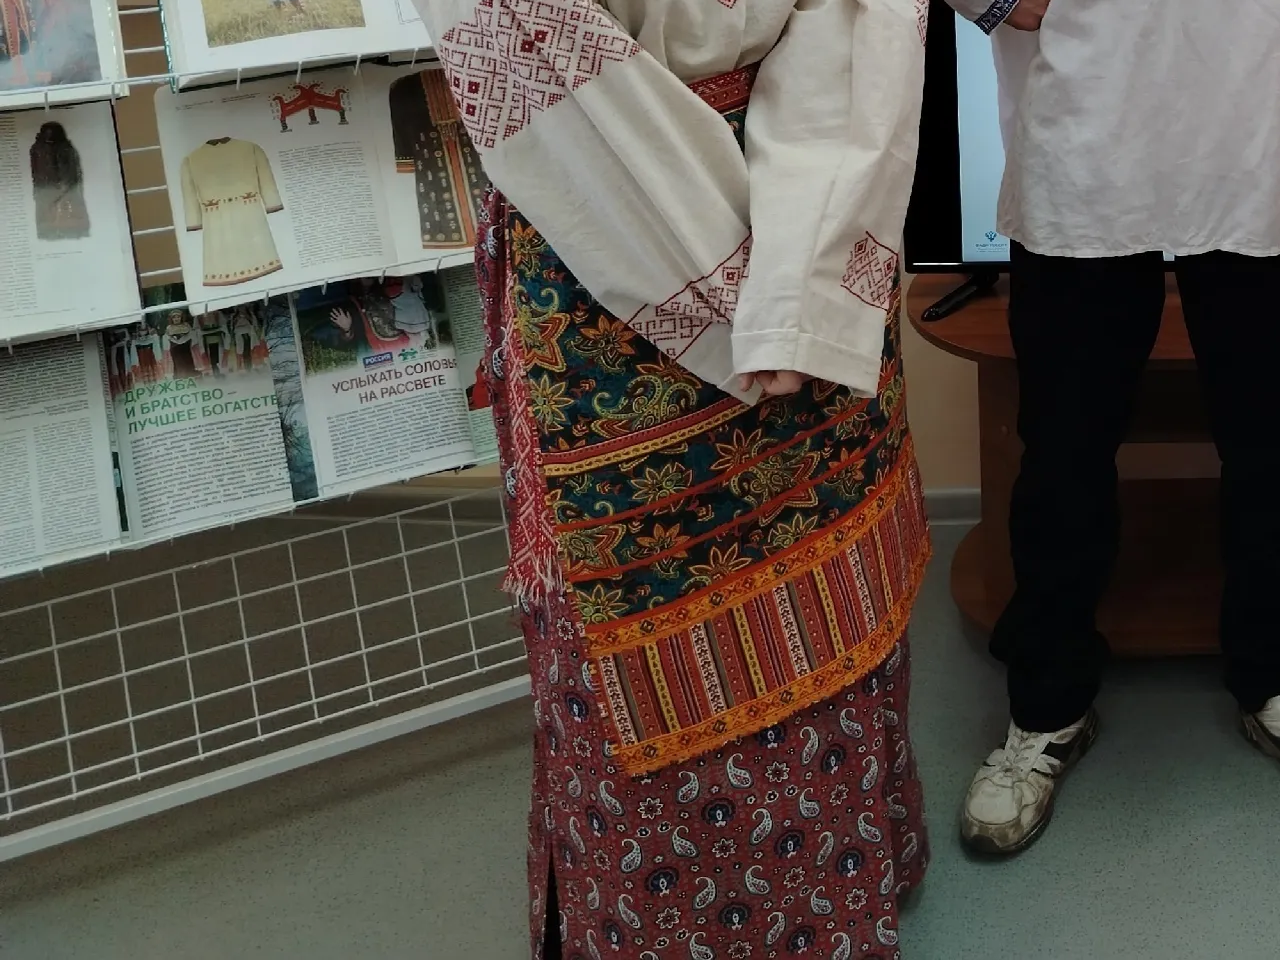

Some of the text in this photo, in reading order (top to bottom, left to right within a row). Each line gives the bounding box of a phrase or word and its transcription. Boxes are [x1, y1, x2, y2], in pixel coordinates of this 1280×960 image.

[124, 377, 197, 406] ДРУЖБА
[332, 368, 403, 394] УСЛЫХАТЬ
[358, 375, 447, 404] НА РАССВЕТЕ
[125, 407, 136, 419] И
[140, 388, 224, 415] БРАТСТВО
[128, 408, 197, 435] ЛУЧШЕЕ
